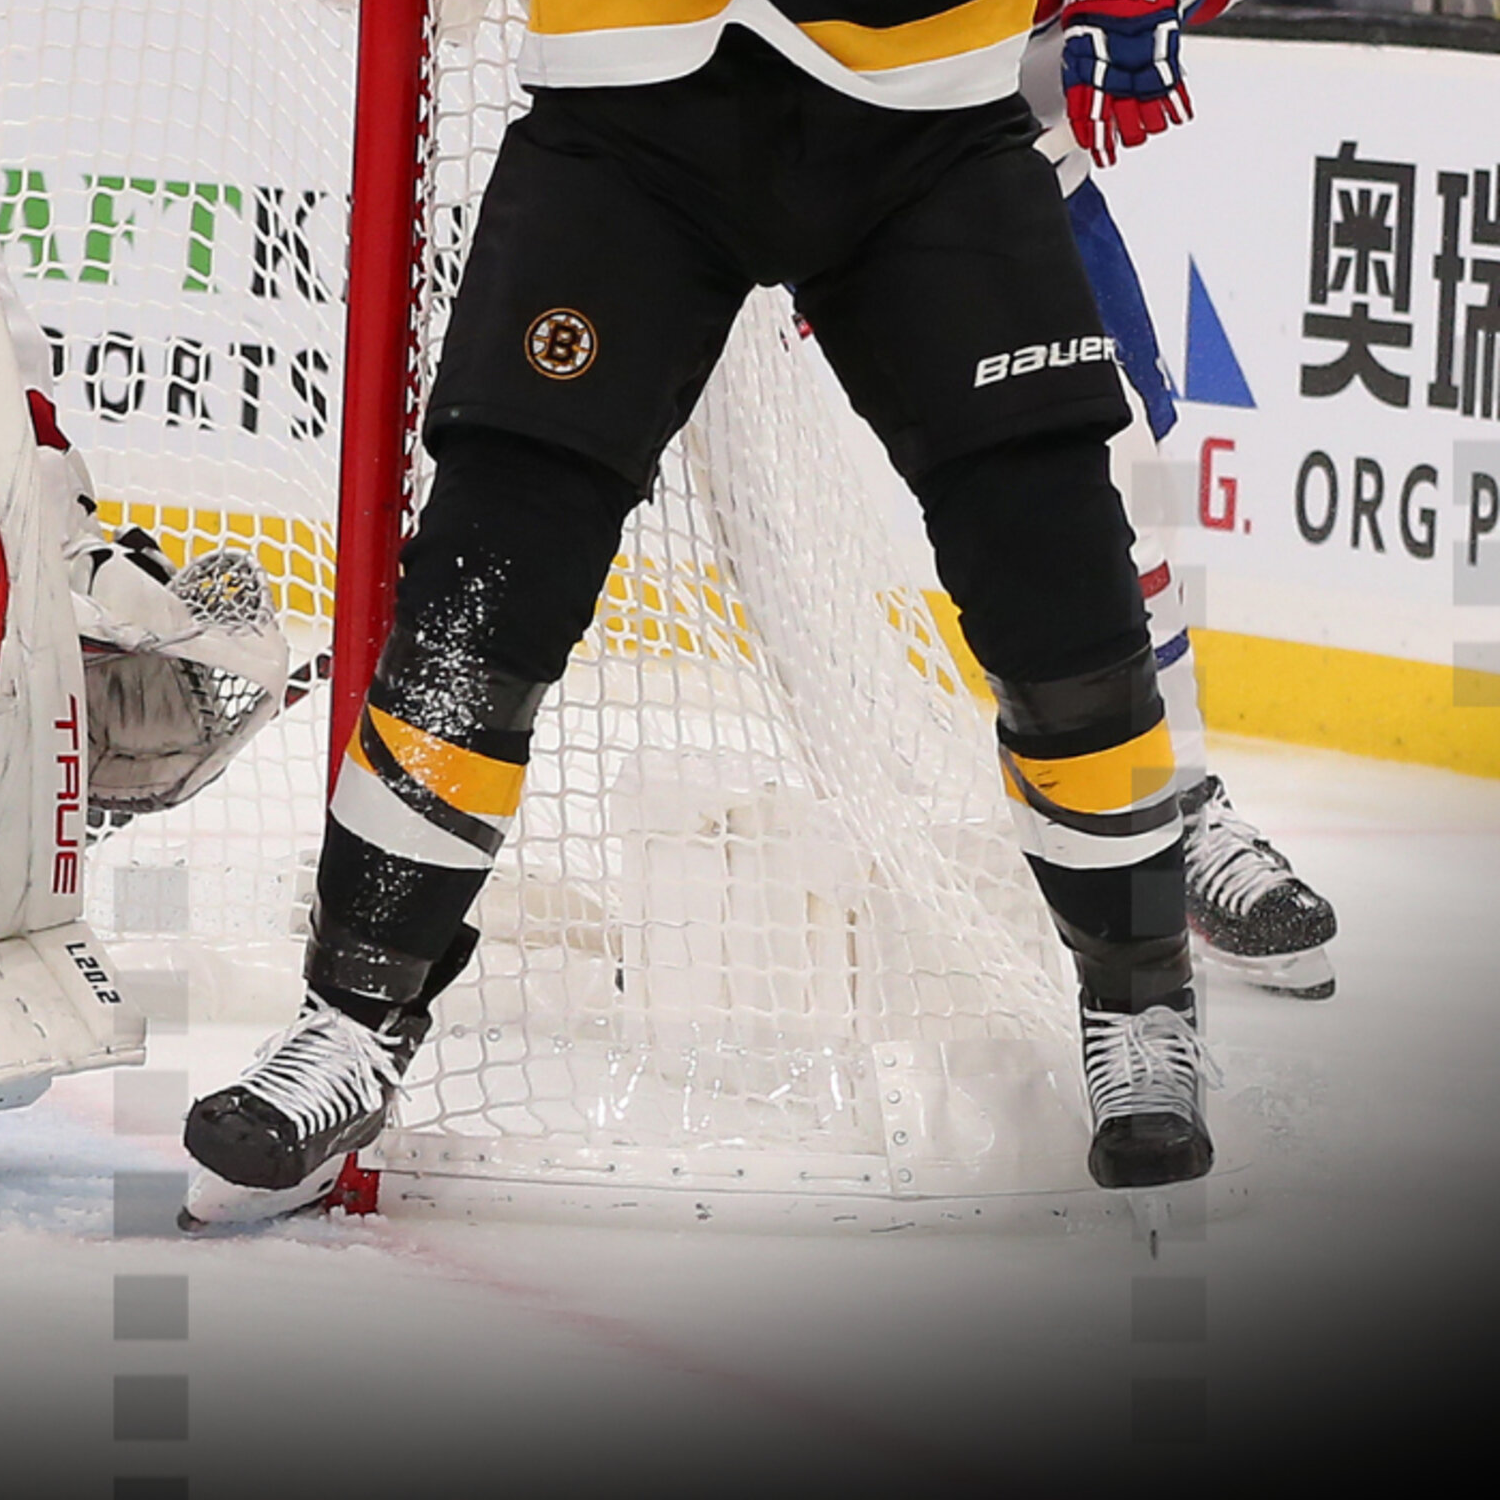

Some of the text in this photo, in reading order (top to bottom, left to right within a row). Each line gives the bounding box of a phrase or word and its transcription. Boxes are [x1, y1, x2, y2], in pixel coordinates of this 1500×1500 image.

[1295, 449, 1440, 560] ORG
[53, 693, 81, 895] TRUE
[64, 941, 122, 1005] L20.2
